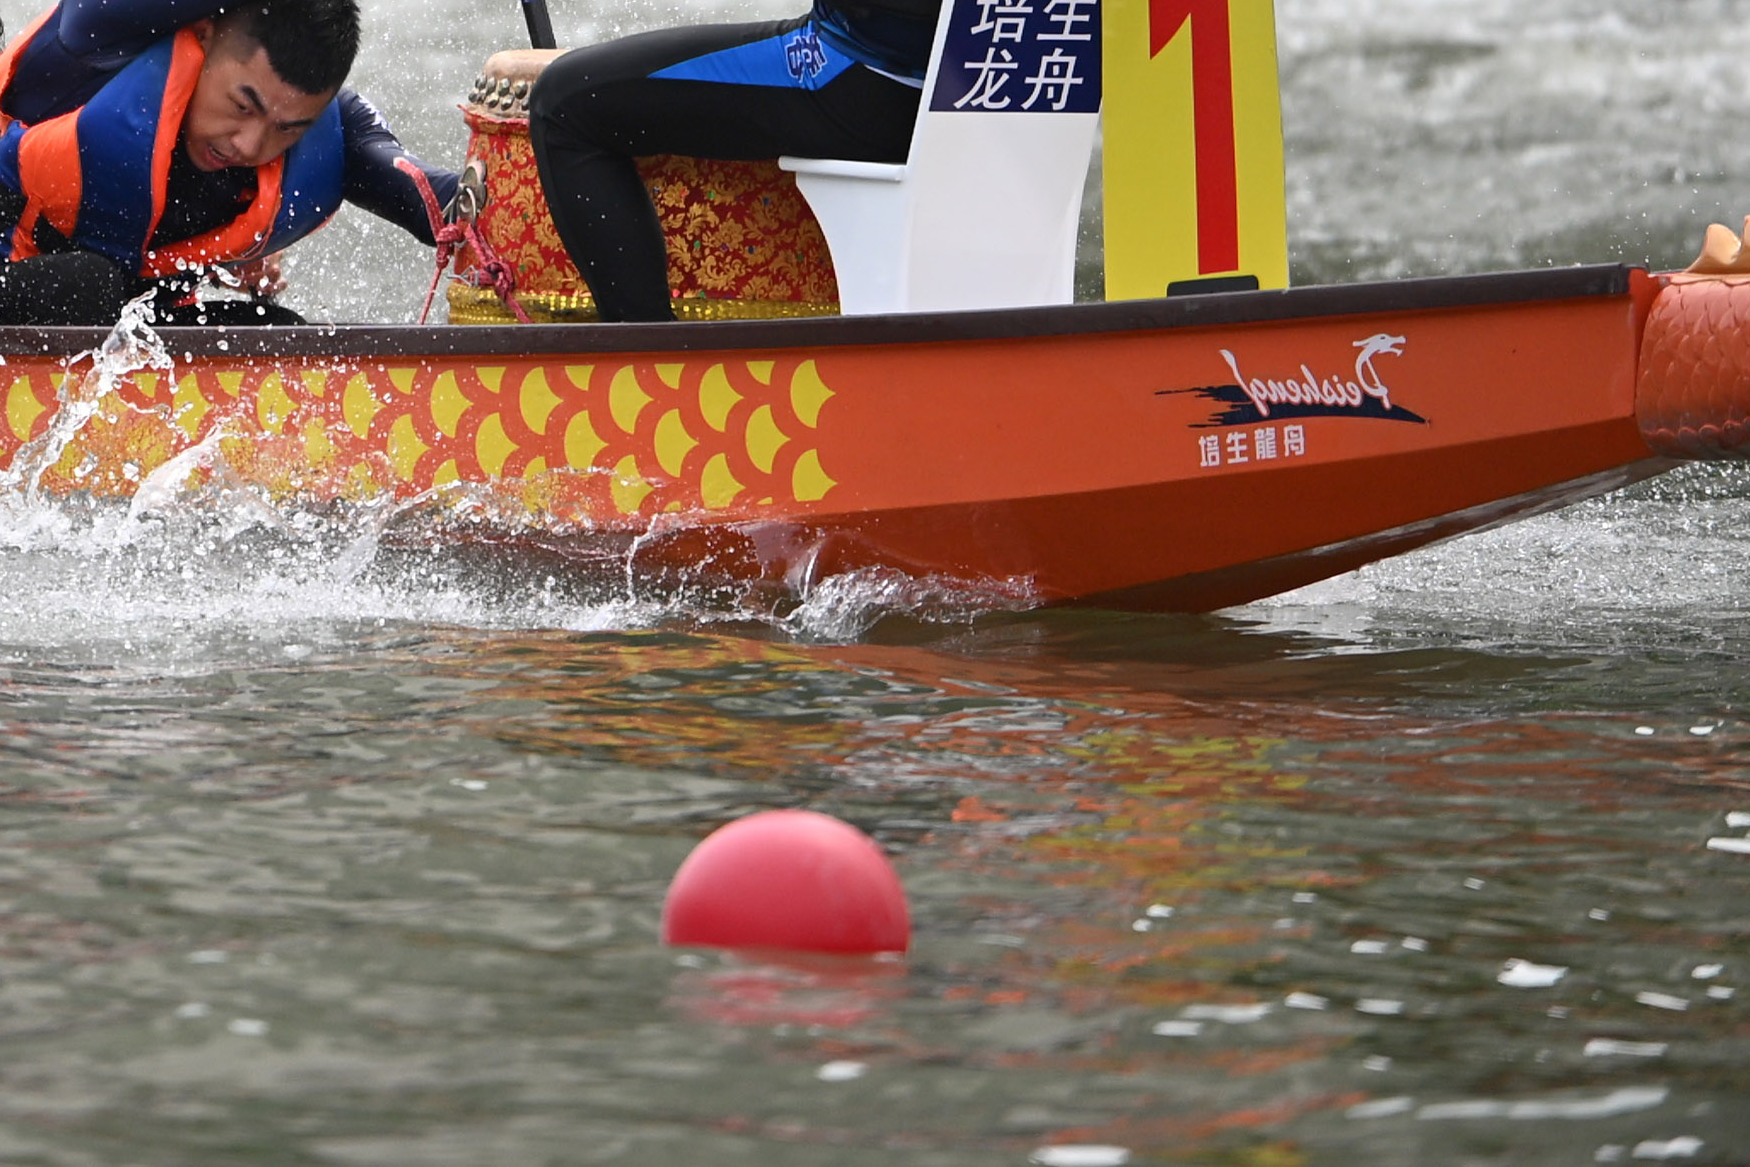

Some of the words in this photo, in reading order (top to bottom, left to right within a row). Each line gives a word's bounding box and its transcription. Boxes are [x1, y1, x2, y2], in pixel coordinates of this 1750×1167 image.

[953, 46, 1084, 111] 龙舟
[1198, 424, 1305, 467] 培生龍舟
